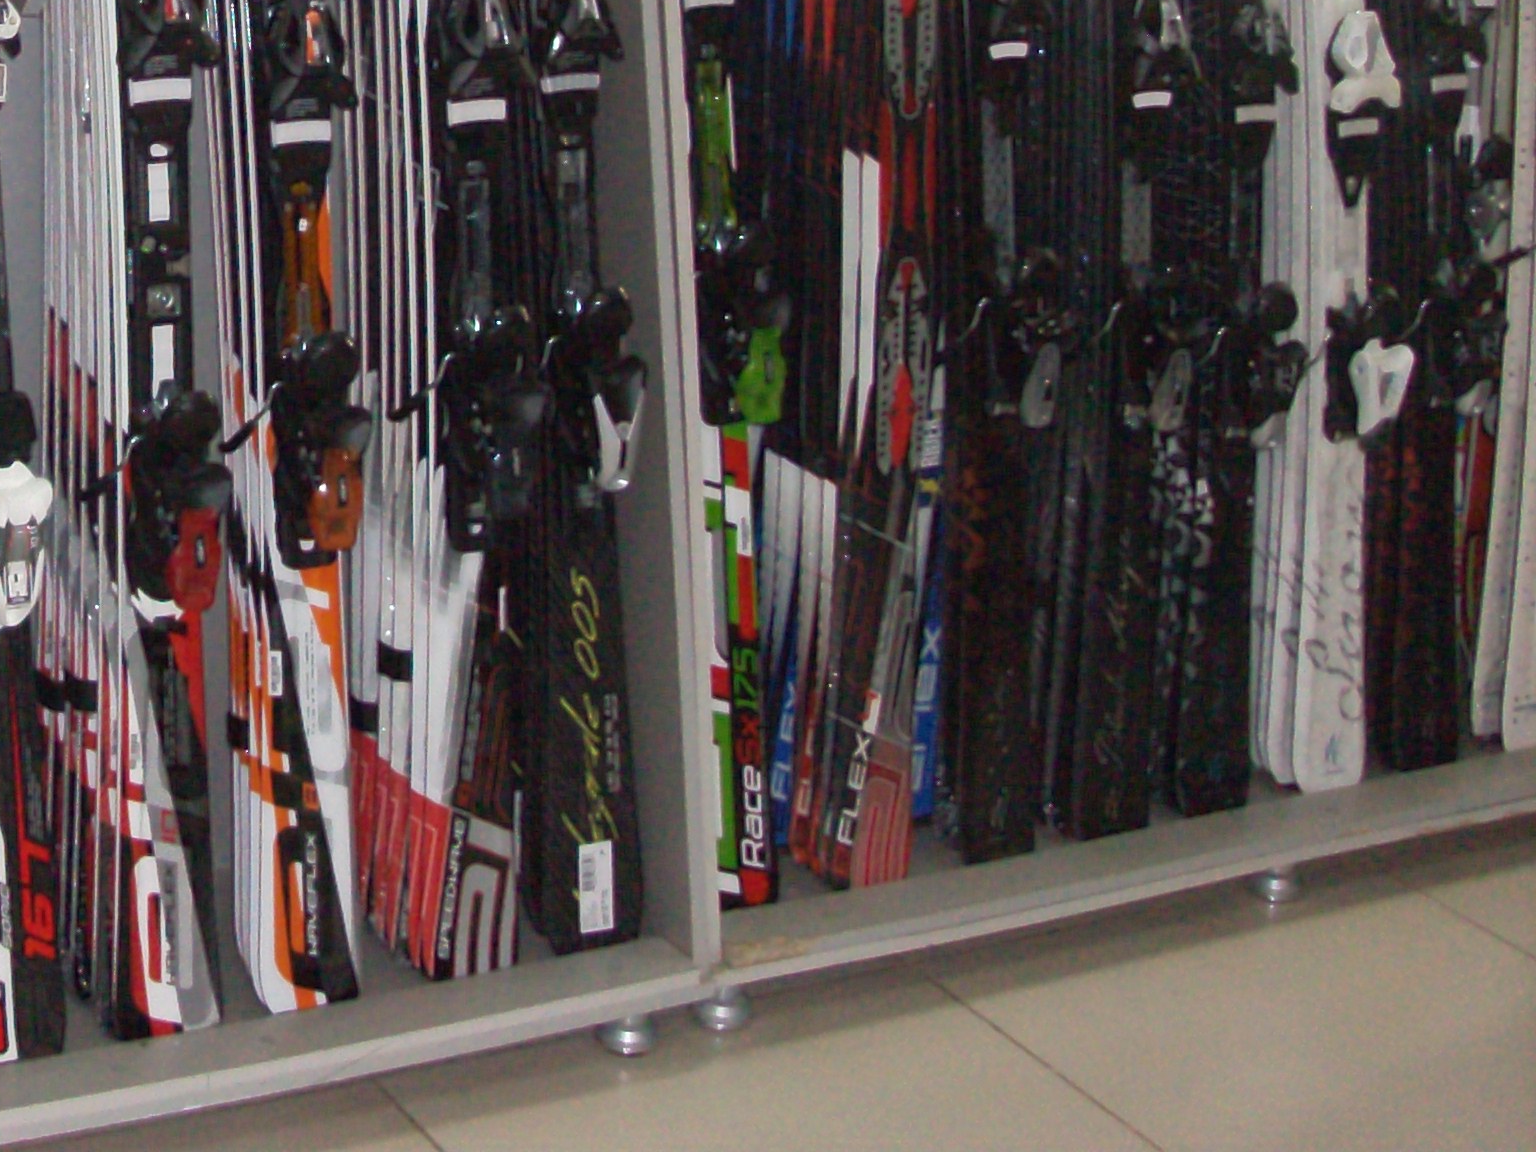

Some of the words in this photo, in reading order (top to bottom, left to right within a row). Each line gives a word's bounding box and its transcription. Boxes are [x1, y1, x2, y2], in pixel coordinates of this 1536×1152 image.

[741, 764, 764, 869] Race
[836, 734, 870, 847] FLEX
[18, 836, 57, 962] 167
[306, 835, 319, 957] WAVEFLEX
